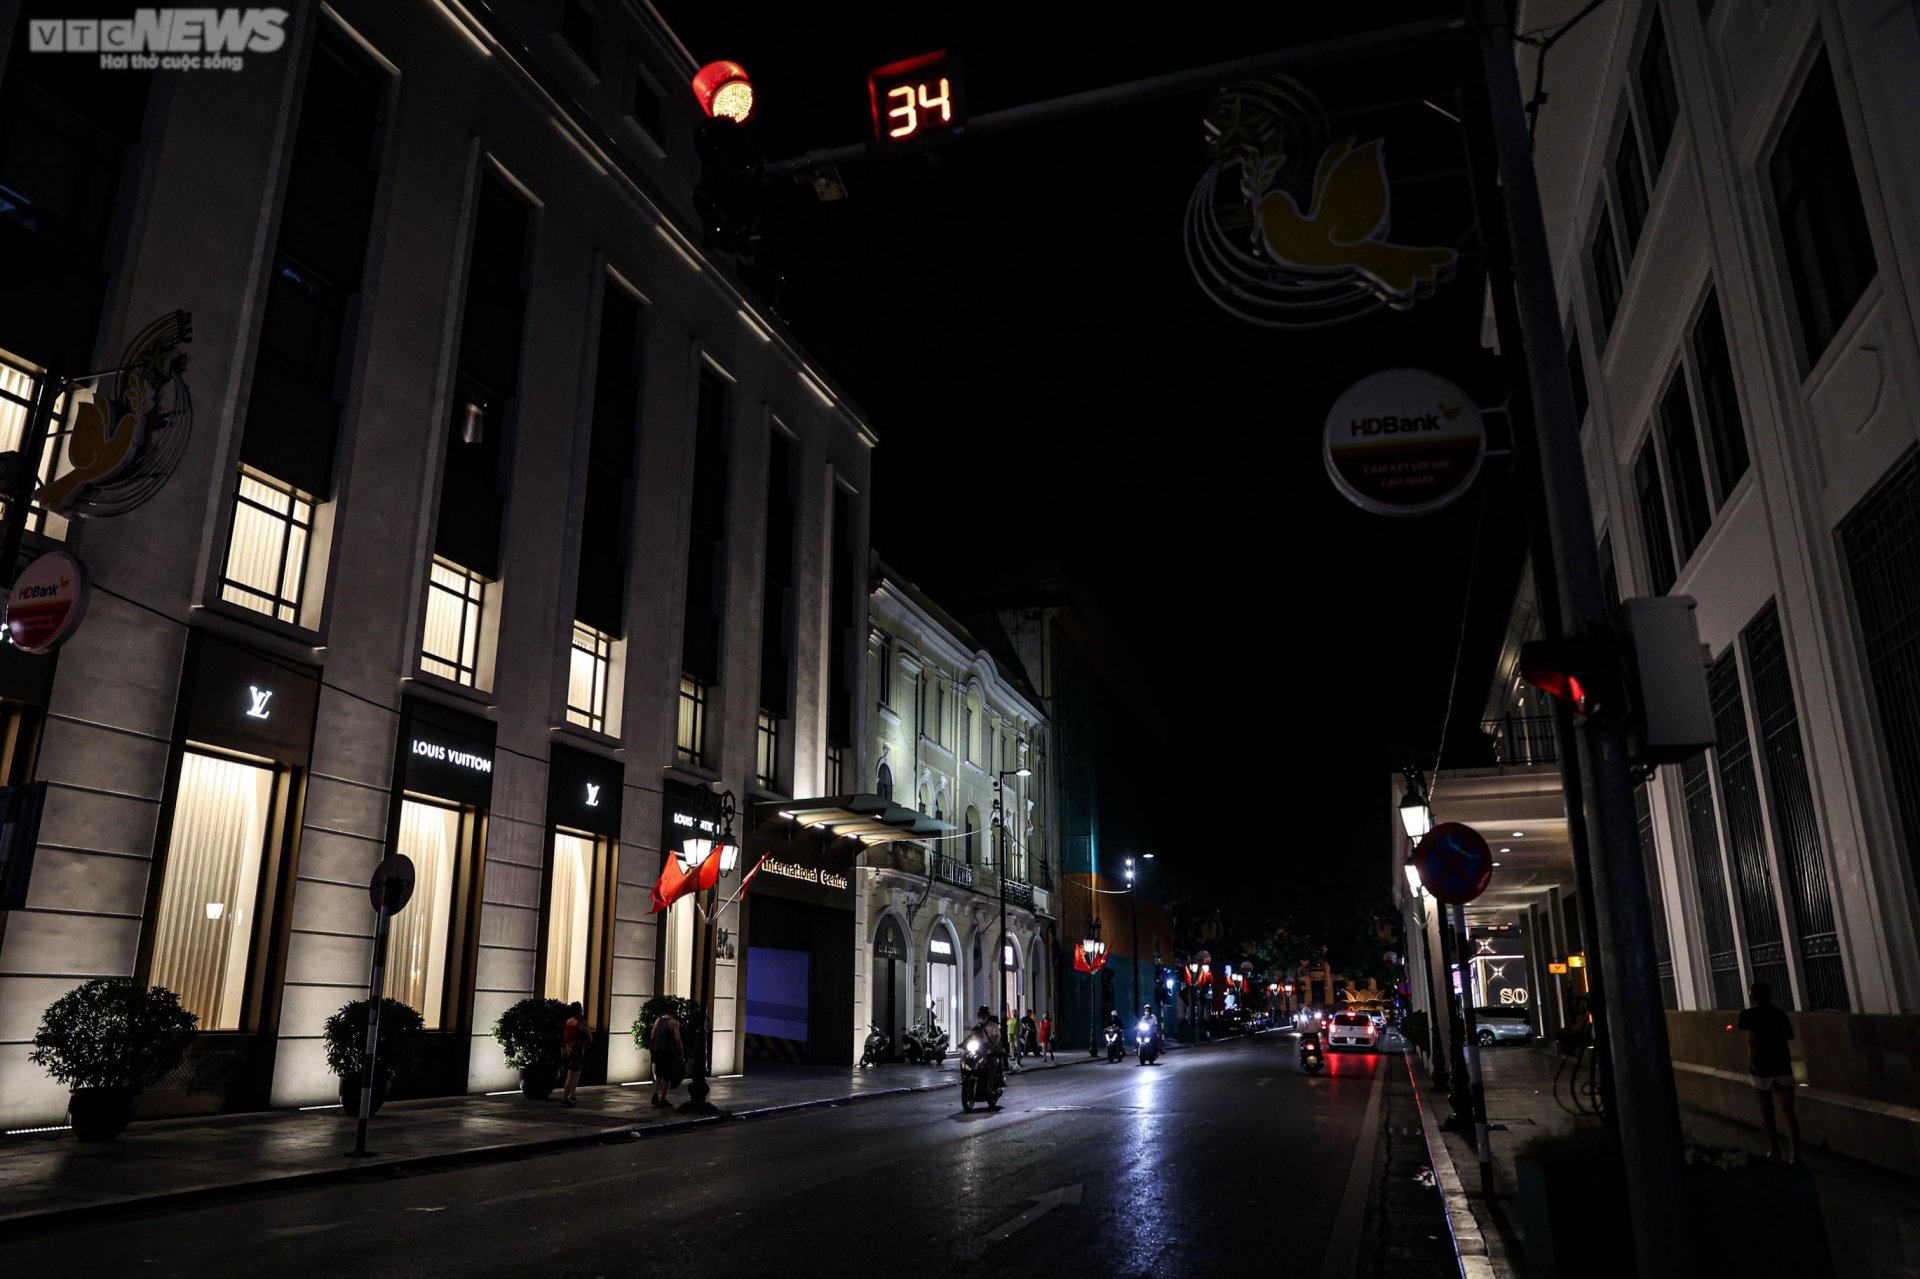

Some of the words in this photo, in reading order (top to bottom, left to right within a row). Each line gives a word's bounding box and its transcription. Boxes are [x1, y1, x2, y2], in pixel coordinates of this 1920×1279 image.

[888, 78, 951, 137] 34
[1351, 414, 1440, 437] HDBank
[19, 584, 58, 600] HDBank
[412, 740, 445, 760] LOUIS
[447, 749, 492, 773] VUITTON
[674, 812, 693, 827] LOUIS
[761, 855, 818, 882] International
[1500, 987, 1528, 1004] SO
